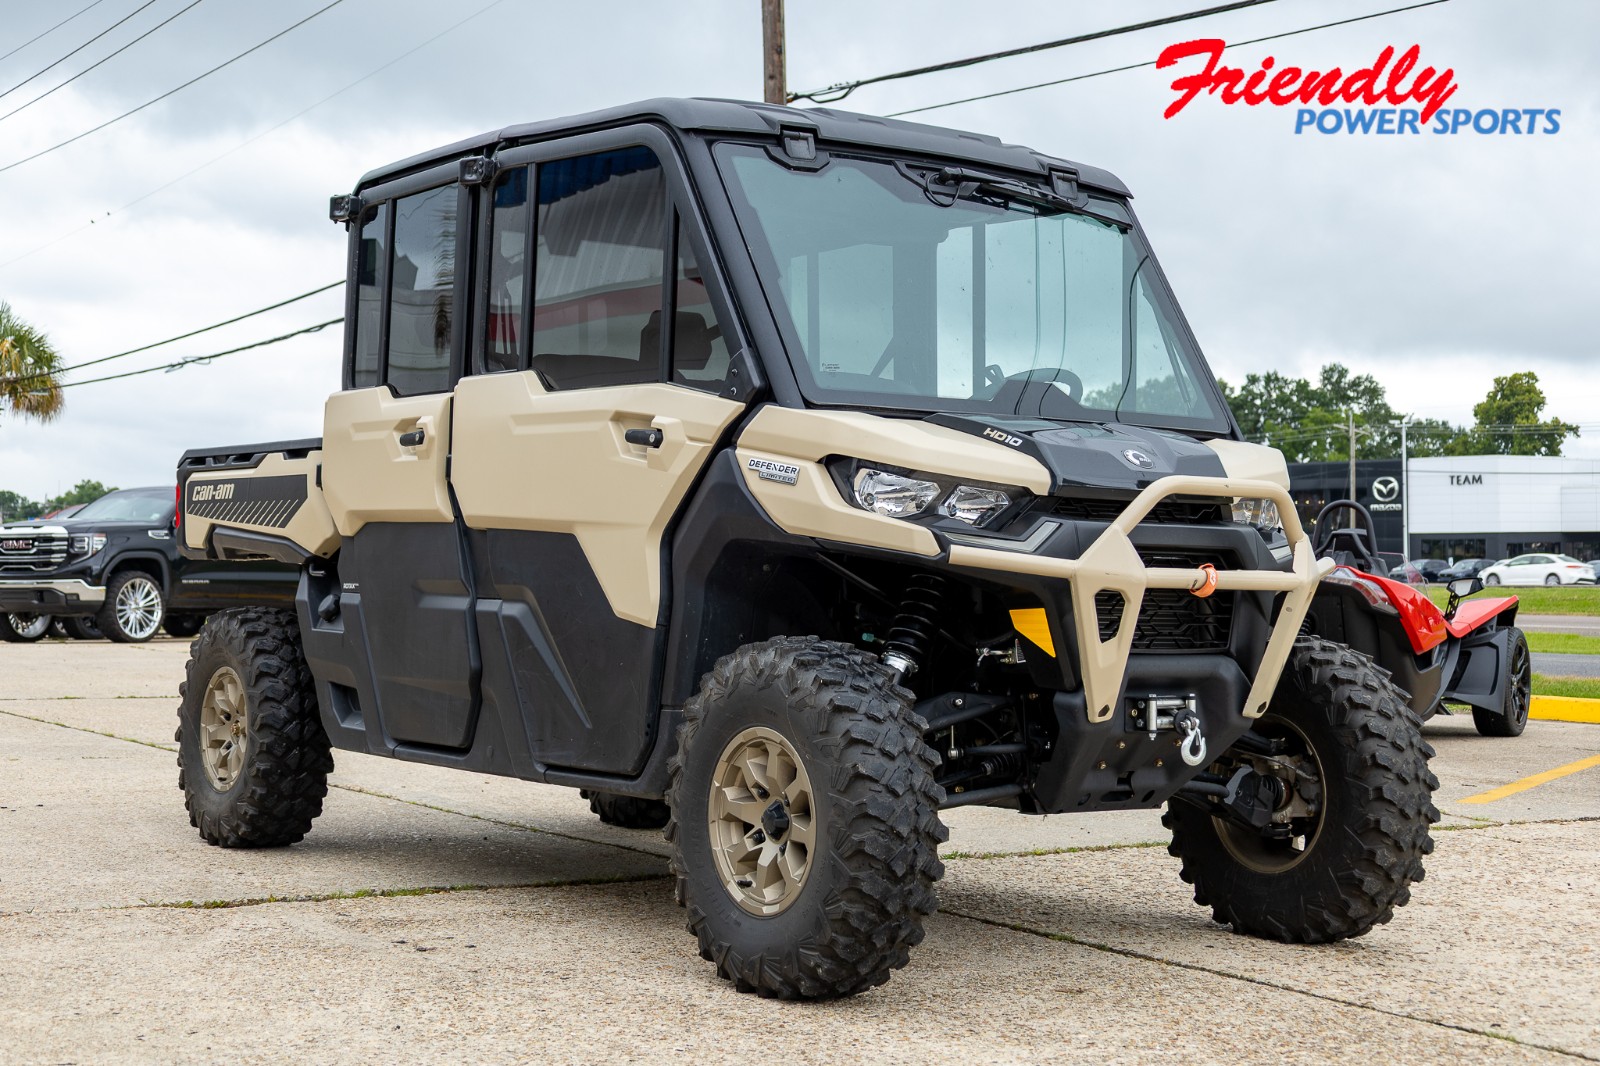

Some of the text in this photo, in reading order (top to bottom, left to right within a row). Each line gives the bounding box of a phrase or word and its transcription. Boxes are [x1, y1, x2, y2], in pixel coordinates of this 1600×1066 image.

[983, 427, 1023, 447] HD10
[748, 459, 798, 474] DEFENDER
[1449, 474, 1483, 486] TEAM
[192, 483, 235, 501] can-am
[3, 540, 32, 549] GMC
